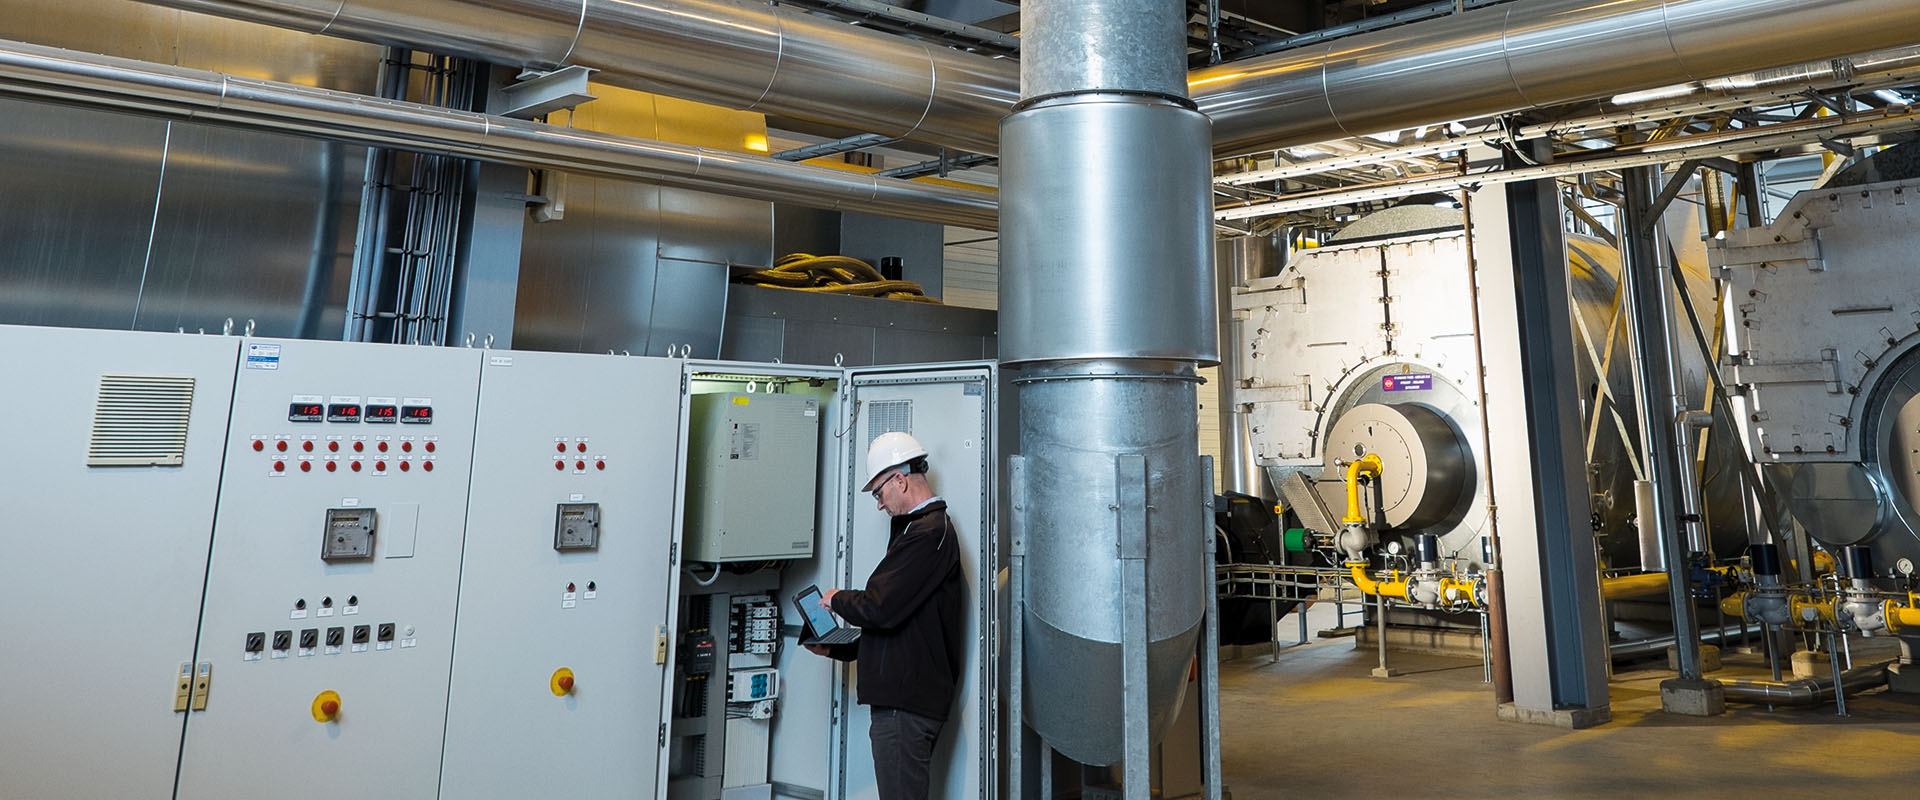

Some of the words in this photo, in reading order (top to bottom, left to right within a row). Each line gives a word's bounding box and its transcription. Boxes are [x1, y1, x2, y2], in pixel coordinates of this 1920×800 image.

[303, 406, 320, 415] 115
[341, 407, 357, 416] 116
[378, 407, 393, 416] 115
[413, 408, 429, 417] 116
